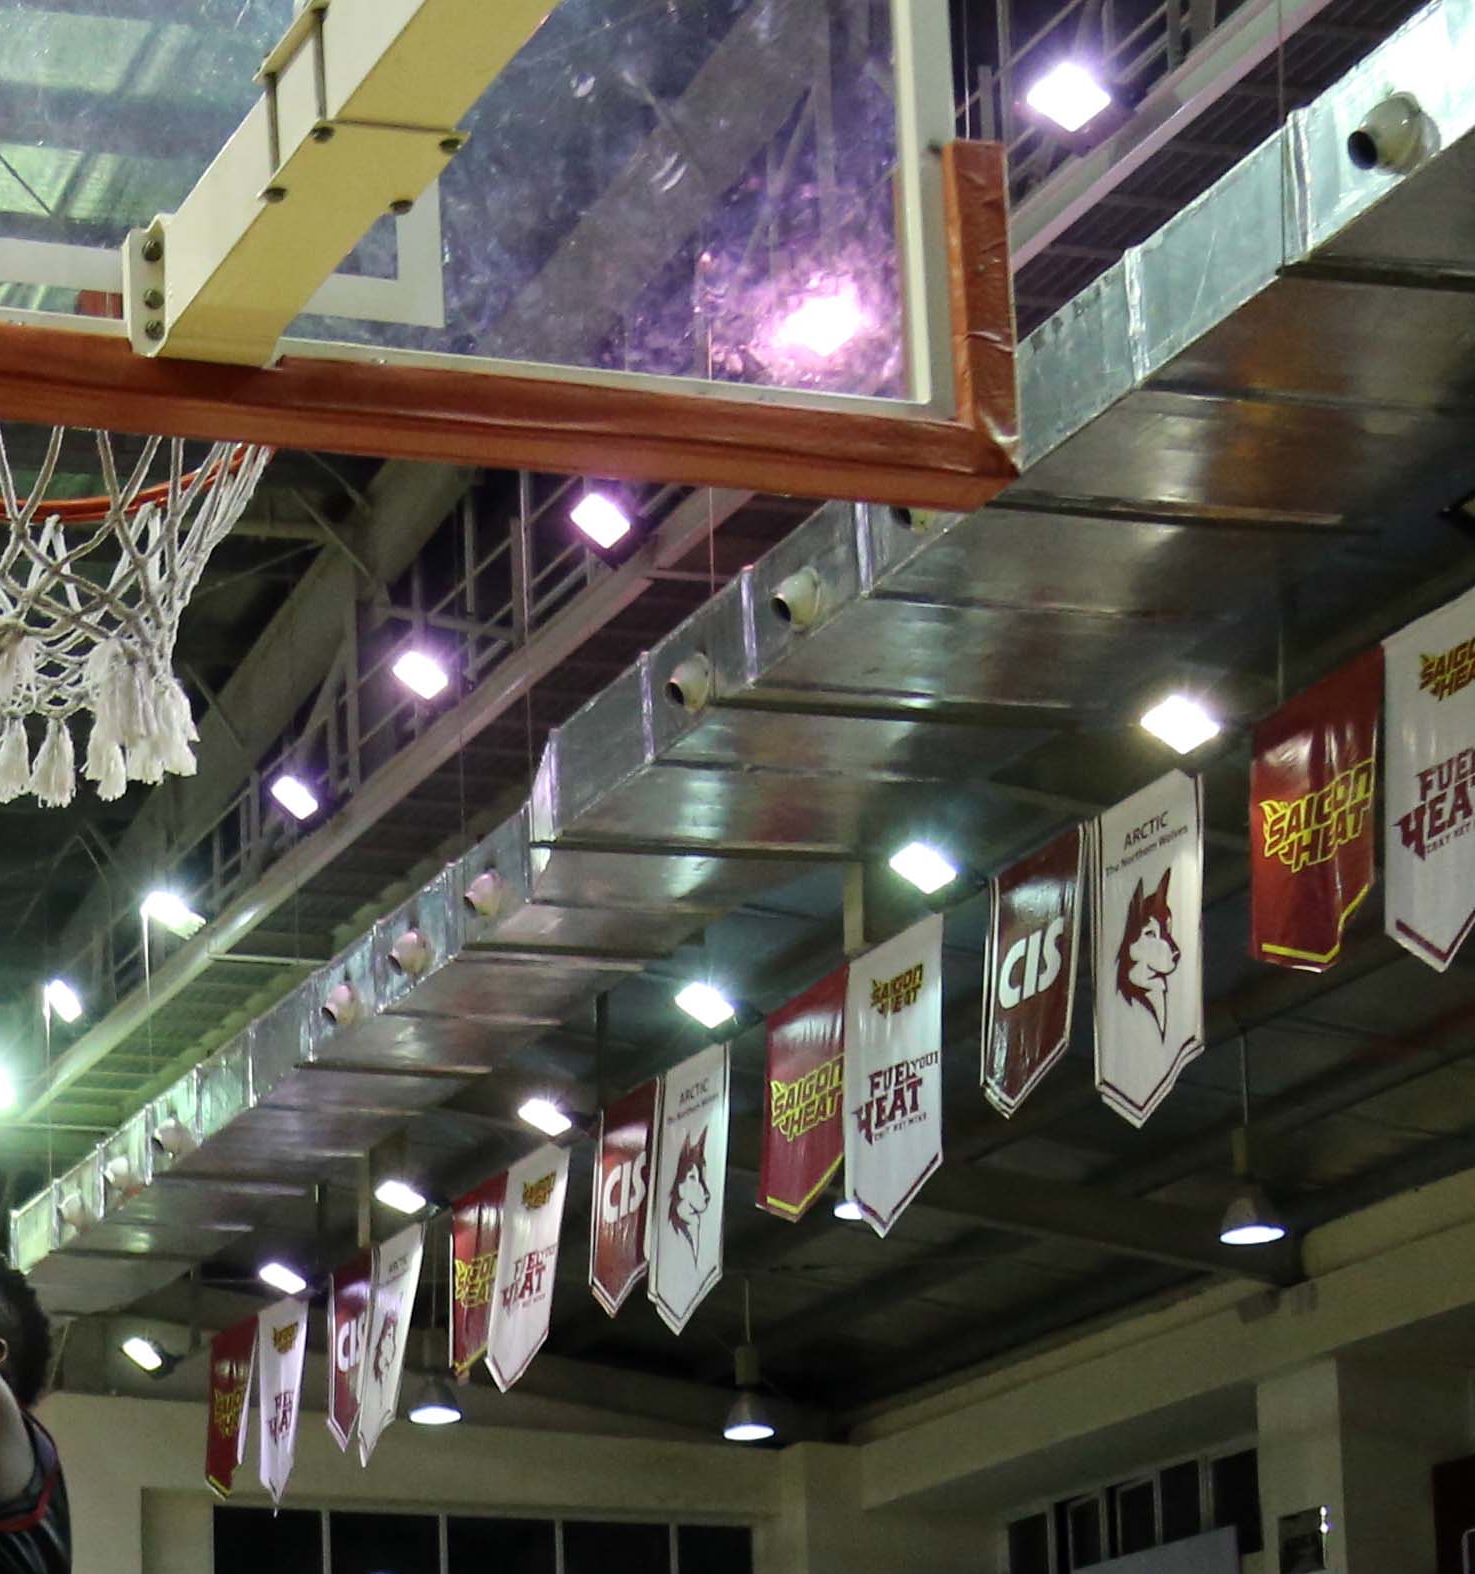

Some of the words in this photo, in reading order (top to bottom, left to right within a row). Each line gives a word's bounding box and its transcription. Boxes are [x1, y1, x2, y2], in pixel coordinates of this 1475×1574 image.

[1124, 811, 1169, 850] ARCTIC
[1259, 757, 1374, 858] SAIGON
[1280, 801, 1370, 874] HEAT
[1000, 917, 1065, 1010] CIS
[852, 1077, 923, 1146] HEAT
[869, 1061, 915, 1098] FUEL
[603, 1151, 647, 1224] CIS
